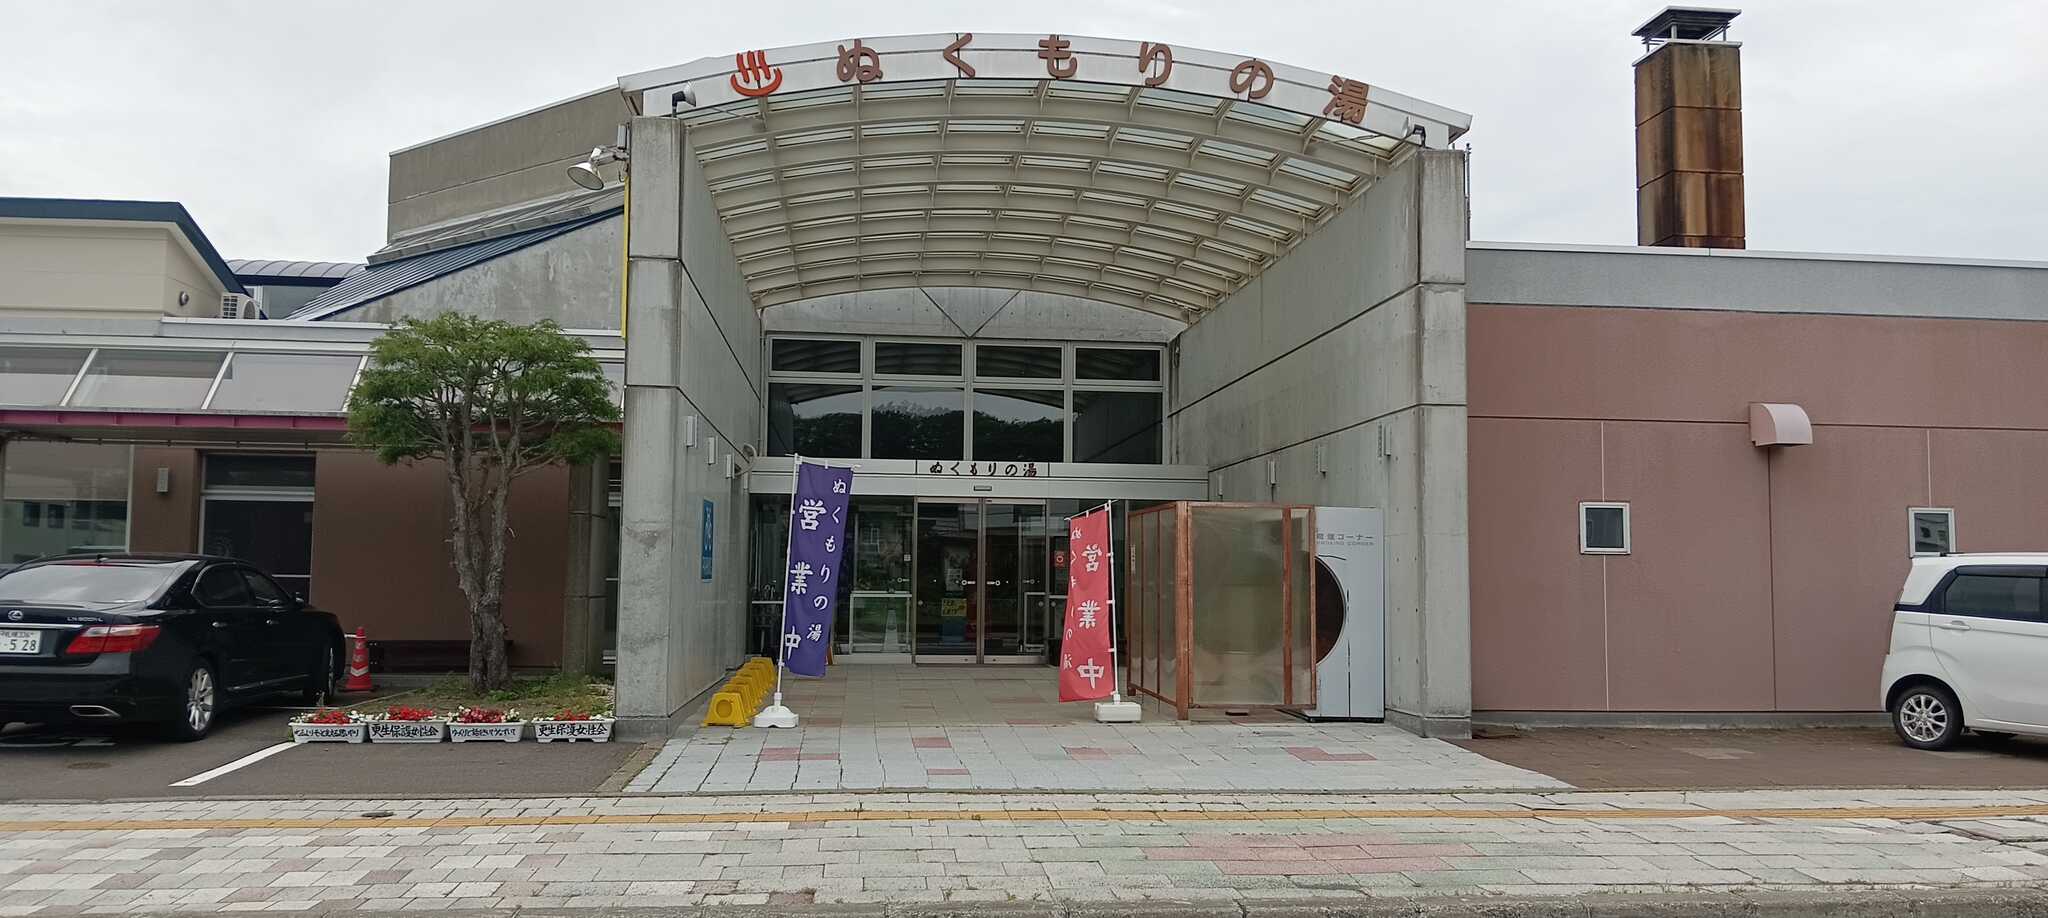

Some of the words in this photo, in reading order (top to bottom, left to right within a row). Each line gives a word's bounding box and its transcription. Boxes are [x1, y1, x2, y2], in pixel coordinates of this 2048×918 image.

[836, 32, 1369, 124] ぬくもりの湯
[929, 461, 1037, 477] ぬくもりの湯
[785, 499, 827, 660] 営業中
[806, 479, 847, 642] ぬくもりの湯
[371, 723, 439, 738] 更生保護女性会
[538, 723, 608, 737] 更生保護女性会
